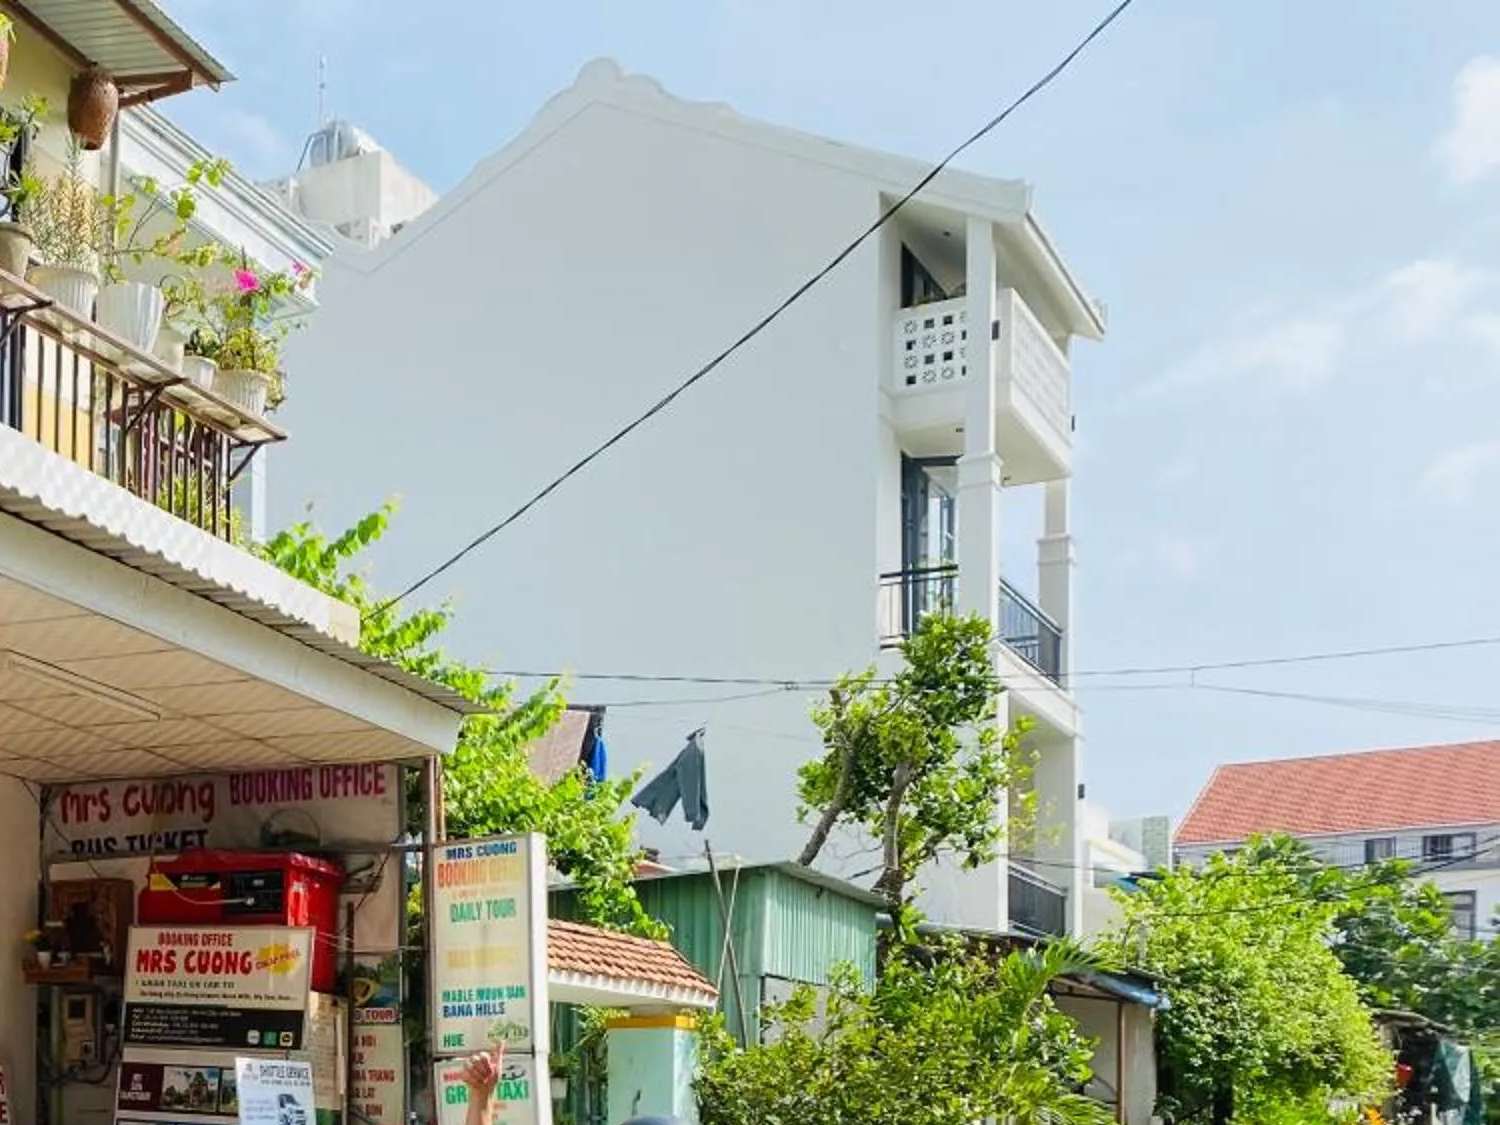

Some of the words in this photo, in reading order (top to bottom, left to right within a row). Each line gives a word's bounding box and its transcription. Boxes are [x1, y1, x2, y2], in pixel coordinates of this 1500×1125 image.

[229, 769, 313, 806] BOOKING
[319, 763, 386, 799] OFFICE
[446, 846, 473, 860] MRS
[201, 932, 233, 947] OFFICE
[136, 949, 177, 973] MRS
[183, 950, 252, 975] CUONG
[443, 1004, 473, 1018] BANA
[476, 1001, 505, 1017] HILLS
[443, 1033, 465, 1048] HUE
